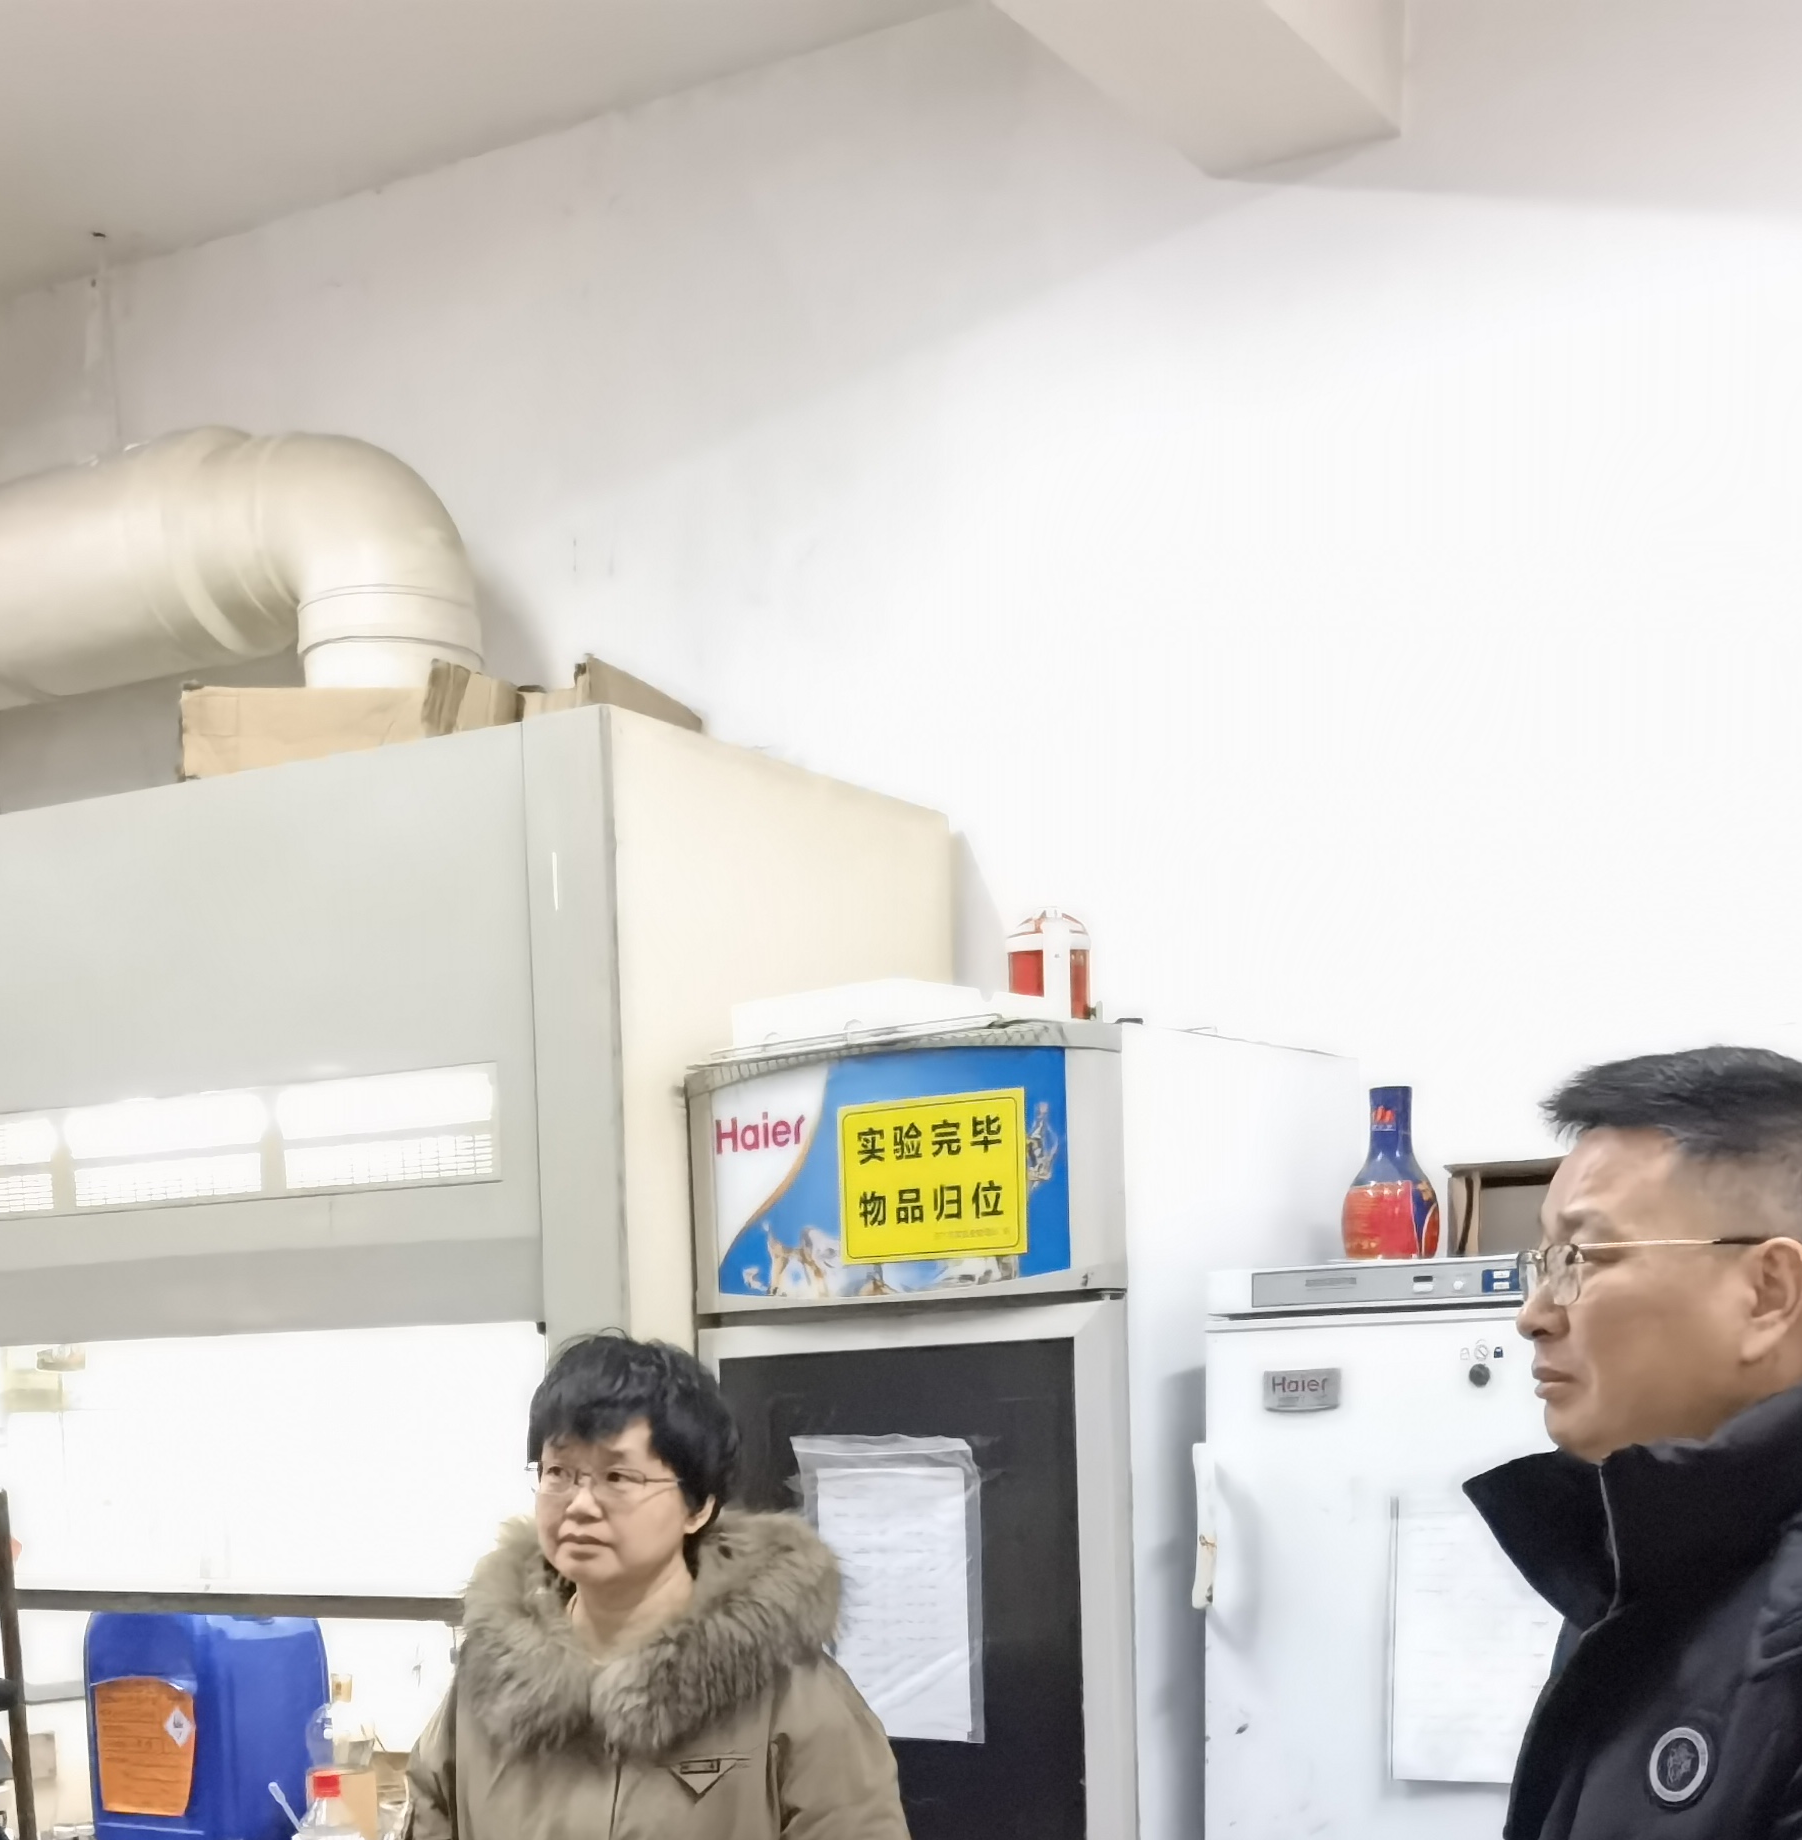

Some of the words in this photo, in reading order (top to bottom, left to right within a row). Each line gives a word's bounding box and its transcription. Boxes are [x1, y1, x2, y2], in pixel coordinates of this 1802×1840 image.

[715, 1111, 806, 1155] Haier
[857, 1114, 1002, 1165] 实验完毕
[859, 1180, 1004, 1228] 物品归位
[1272, 1376, 1328, 1394] Haier
